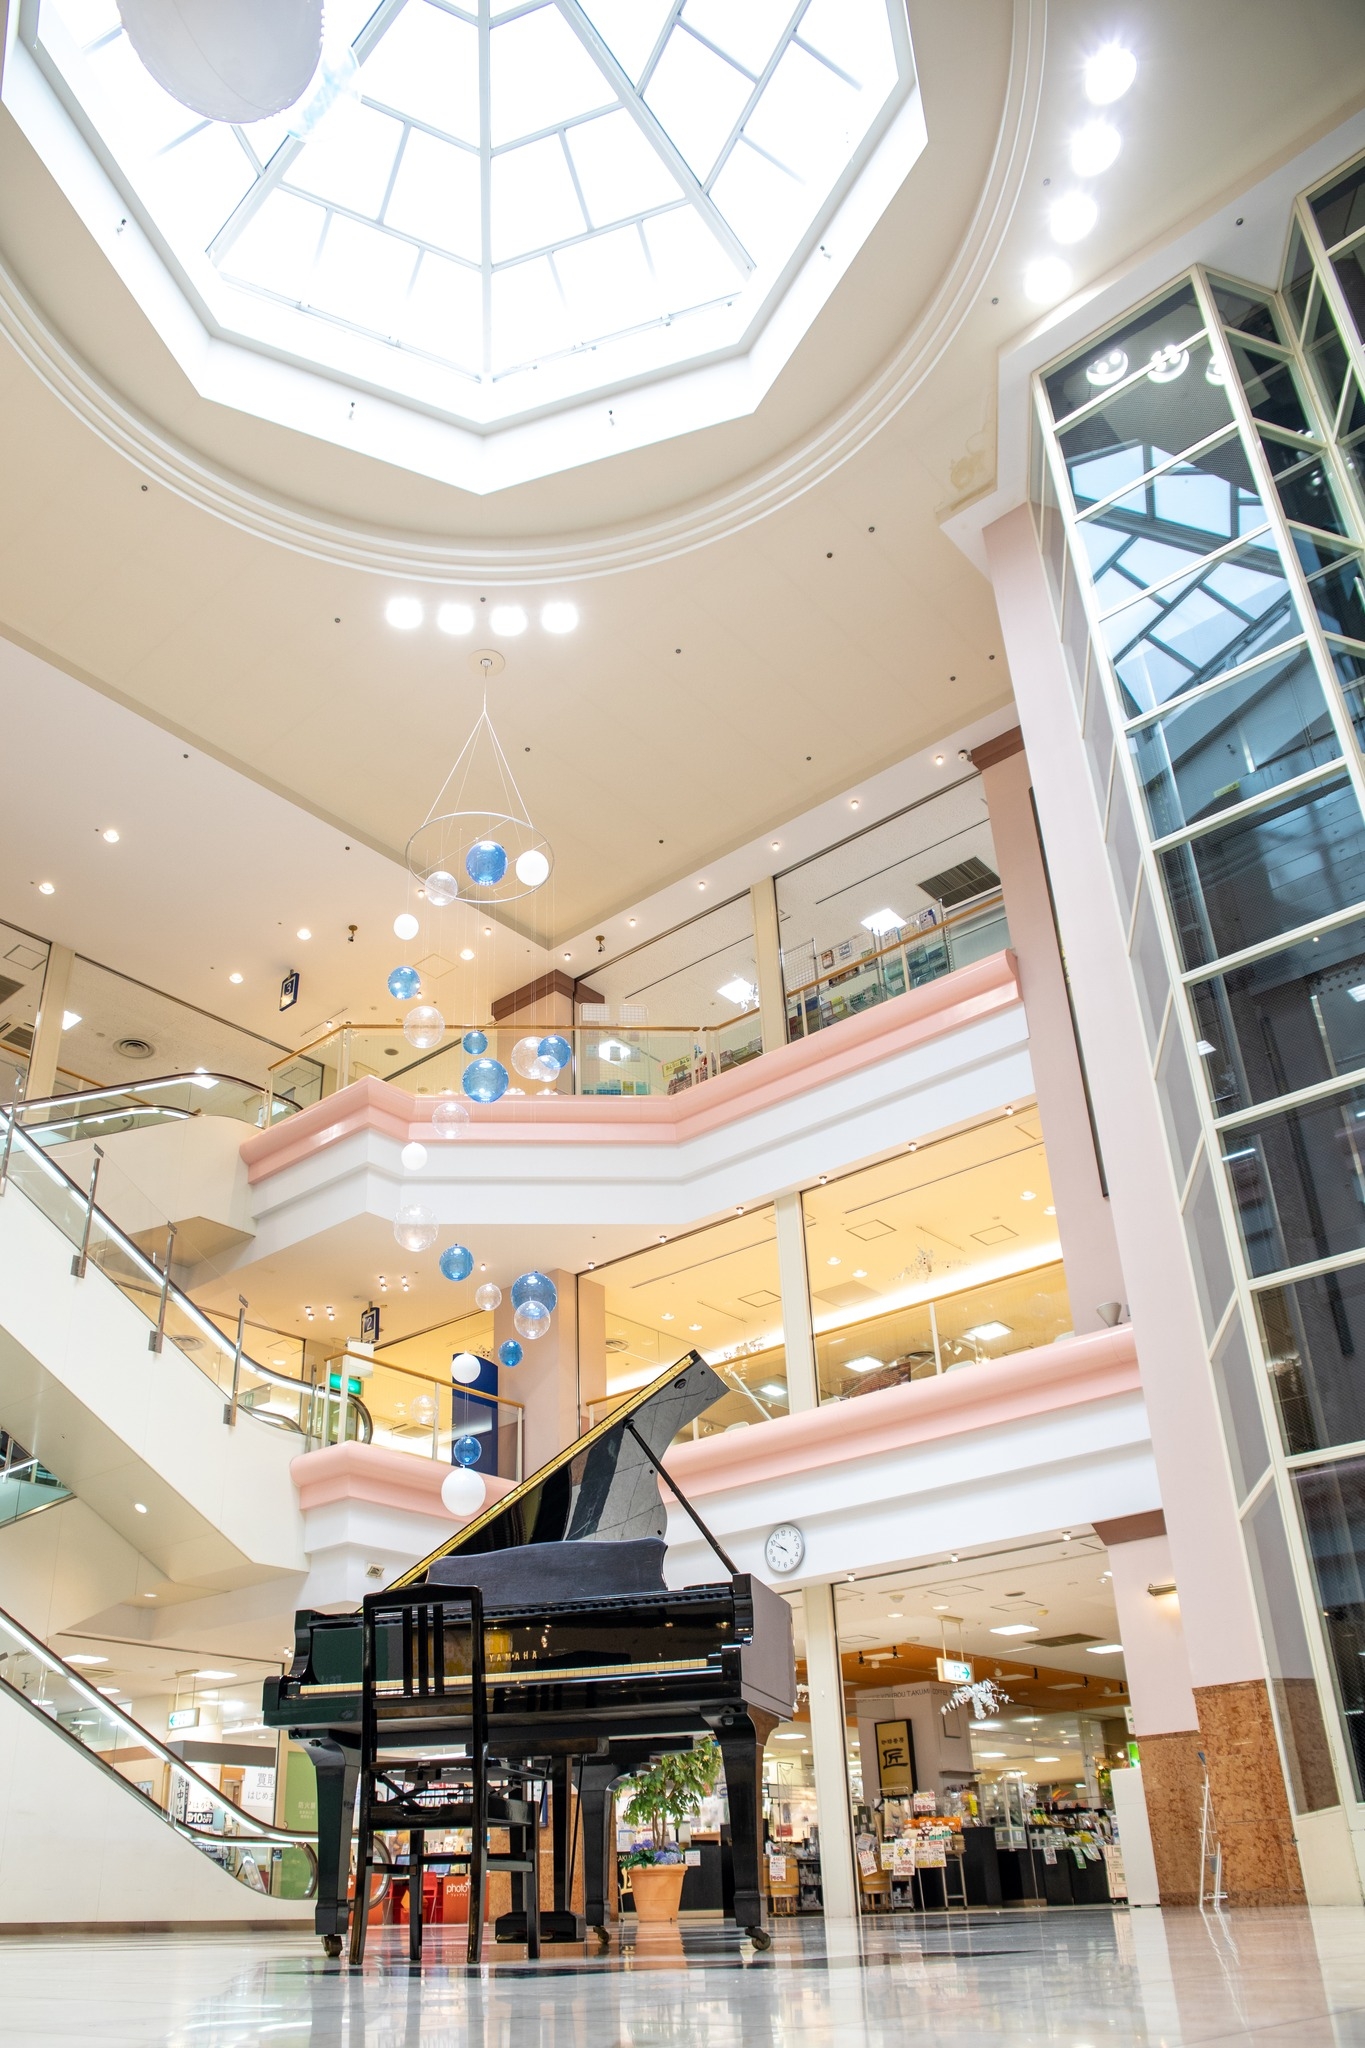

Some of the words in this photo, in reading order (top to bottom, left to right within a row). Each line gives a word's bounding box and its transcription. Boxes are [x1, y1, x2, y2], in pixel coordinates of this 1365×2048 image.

[286, 983, 291, 995] 3
[366, 1317, 372, 1331] 2
[489, 1650, 538, 1663] YAMAHA
[882, 1748, 909, 1770] 匠
